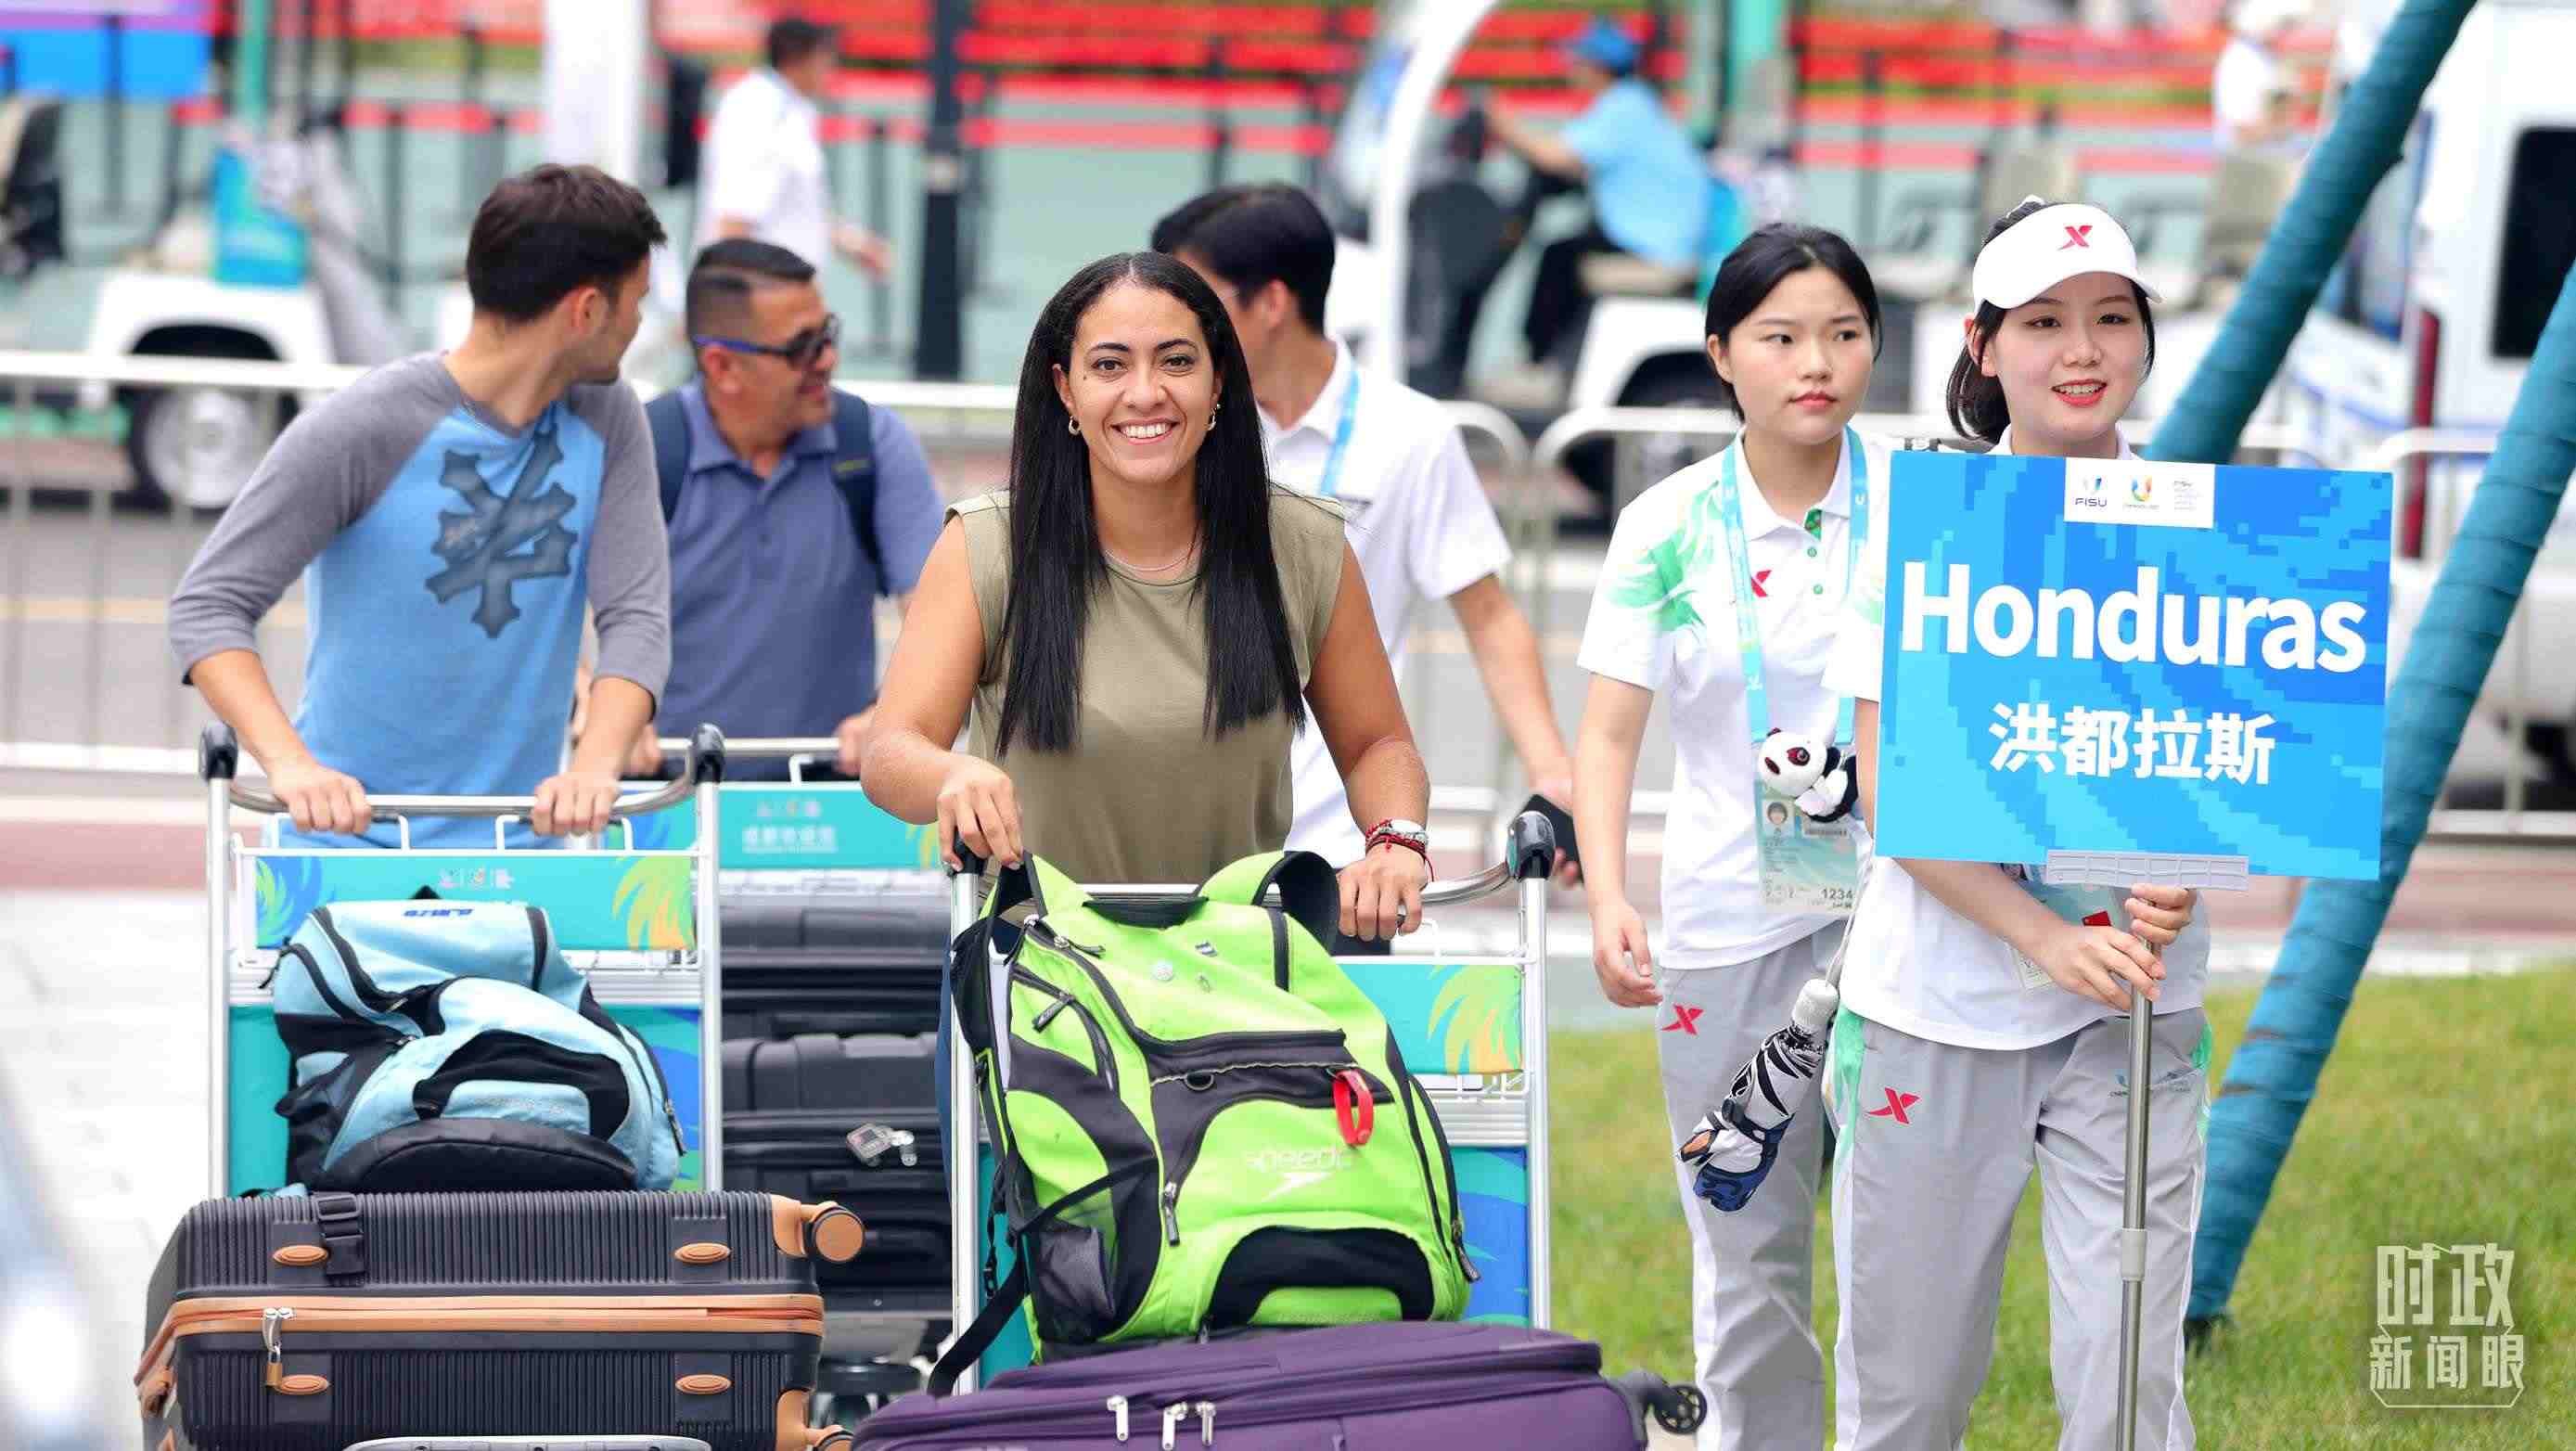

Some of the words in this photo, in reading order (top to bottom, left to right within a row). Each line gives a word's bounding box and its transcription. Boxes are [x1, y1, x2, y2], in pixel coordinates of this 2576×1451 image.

[2075, 497, 2108, 507] FISU
[1902, 560, 2367, 674] Honduras
[1988, 702, 2275, 785] 洪都拉斯
